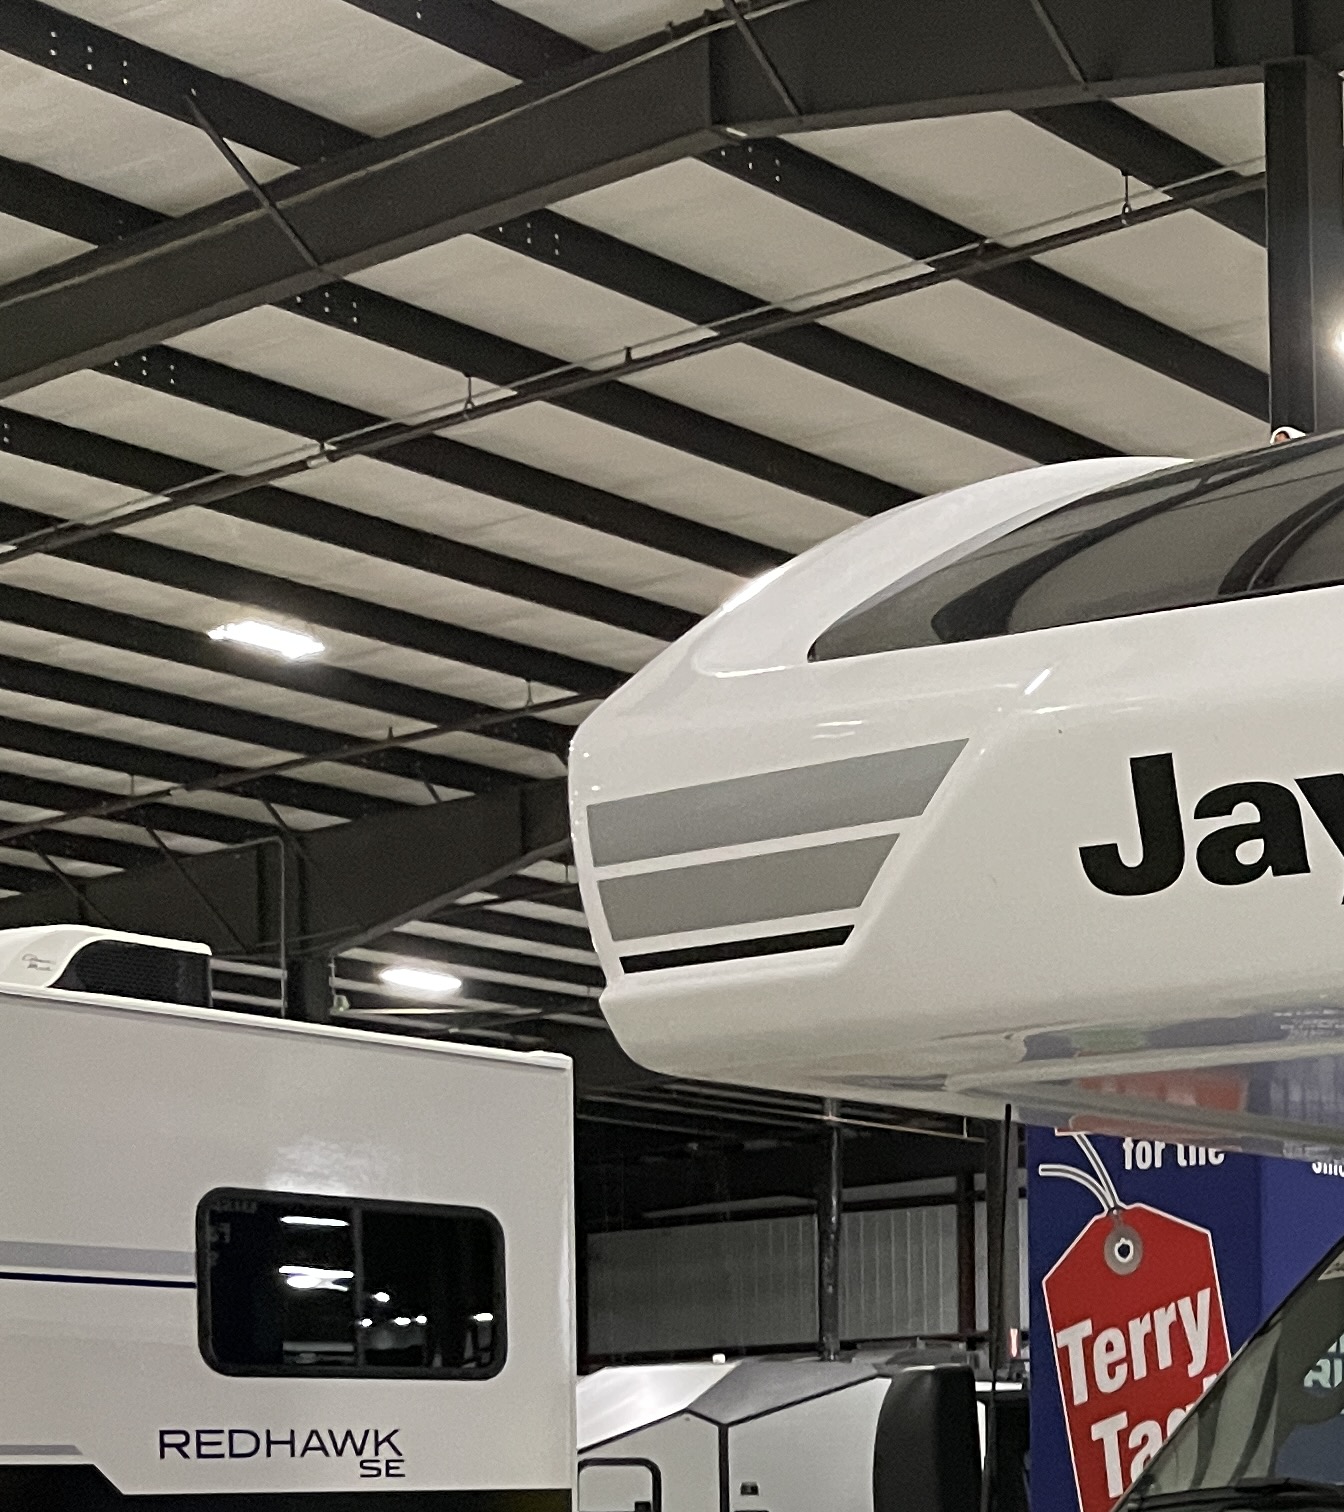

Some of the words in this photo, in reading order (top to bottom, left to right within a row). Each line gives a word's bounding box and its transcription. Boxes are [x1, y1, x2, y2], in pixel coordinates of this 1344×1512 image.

[1056, 1287, 1211, 1406] Terry
[158, 1428, 404, 1460] REDHAWK
[358, 1458, 406, 1478] SE
